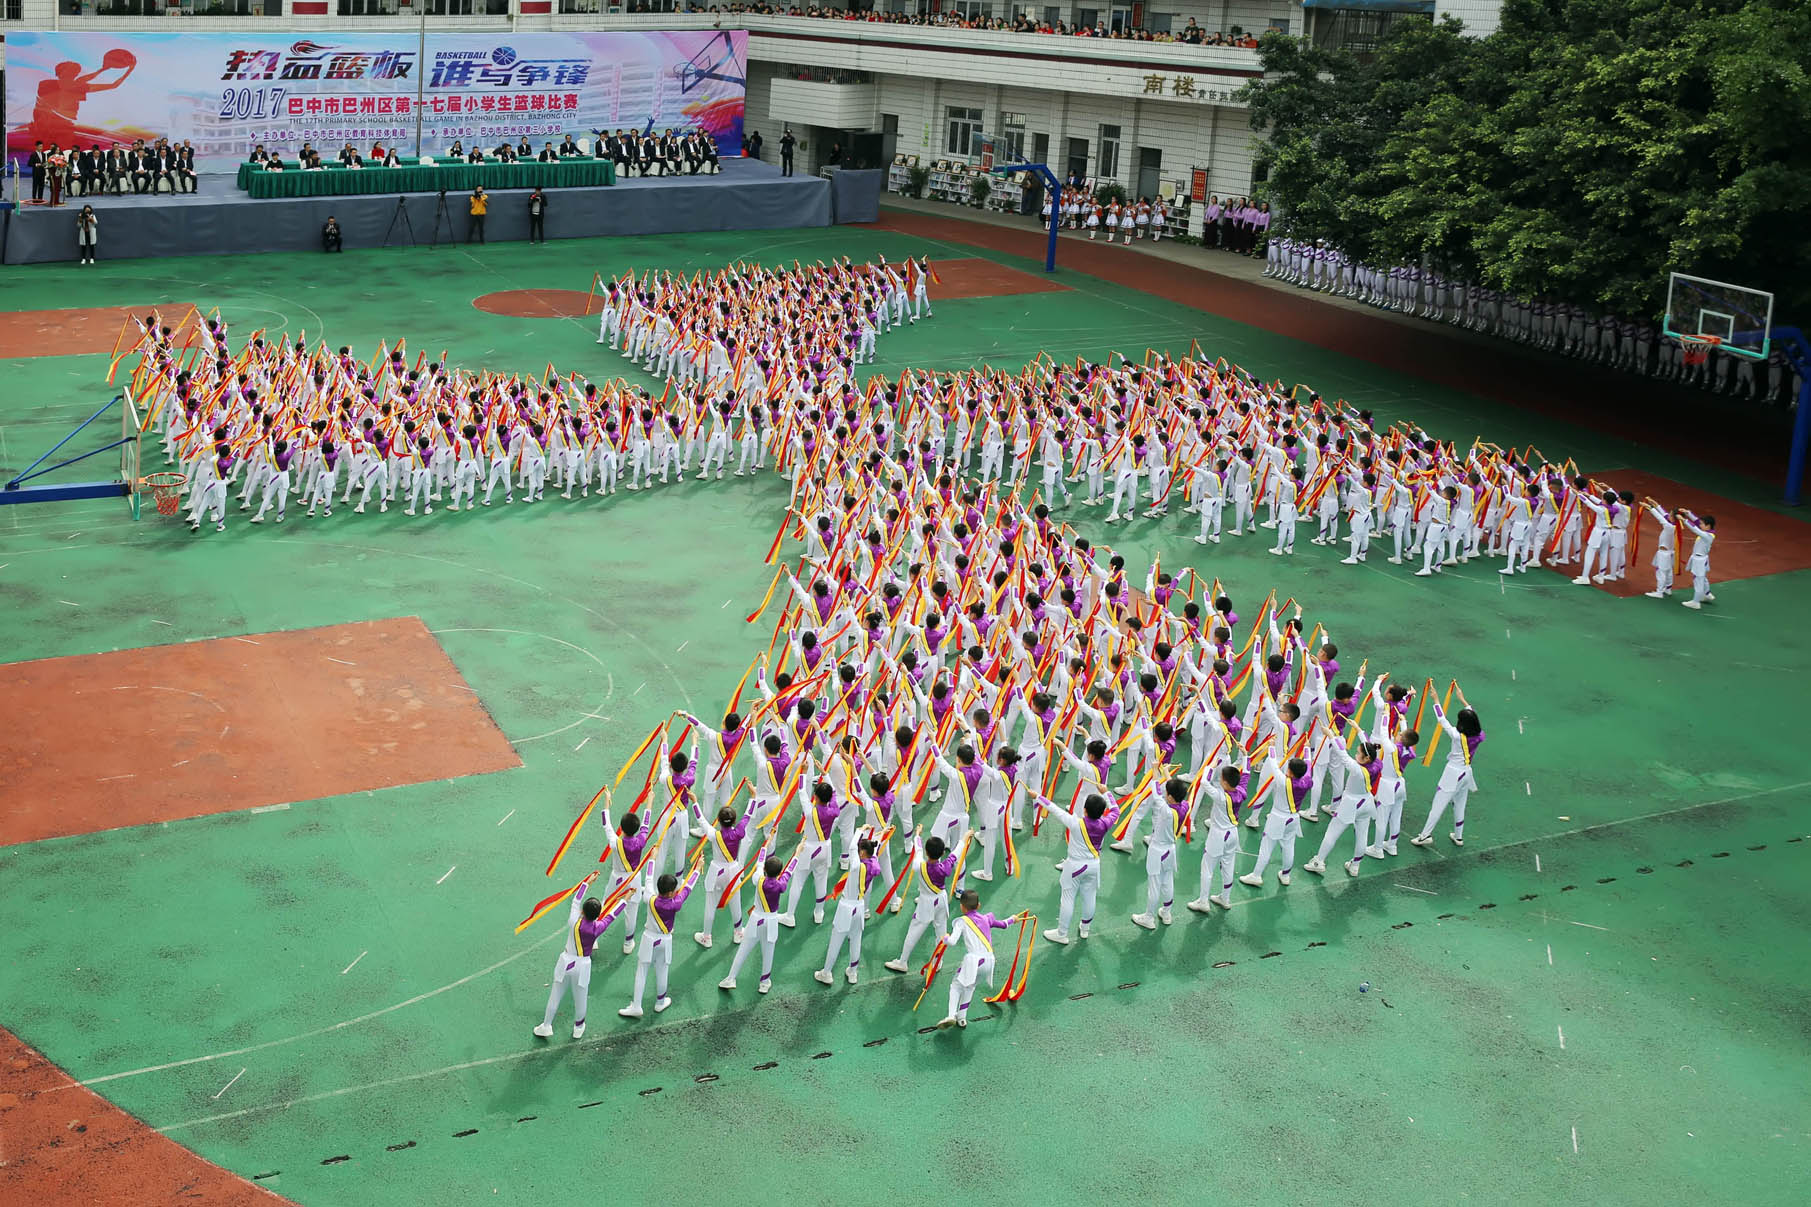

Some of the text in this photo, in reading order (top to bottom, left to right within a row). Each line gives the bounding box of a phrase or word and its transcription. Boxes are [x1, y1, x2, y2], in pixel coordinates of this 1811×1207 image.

[220, 49, 416, 80] 热血篮板
[435, 51, 487, 60] BASKETBALL
[429, 59, 592, 88] 谁与争锋
[1143, 73, 1196, 98] 南楼
[219, 87, 286, 118] 2017
[289, 117, 302, 125] THE
[389, 115, 432, 123] BASKETALL
[464, 113, 493, 121] BAZHOU
[528, 112, 560, 120] BAZHONG
